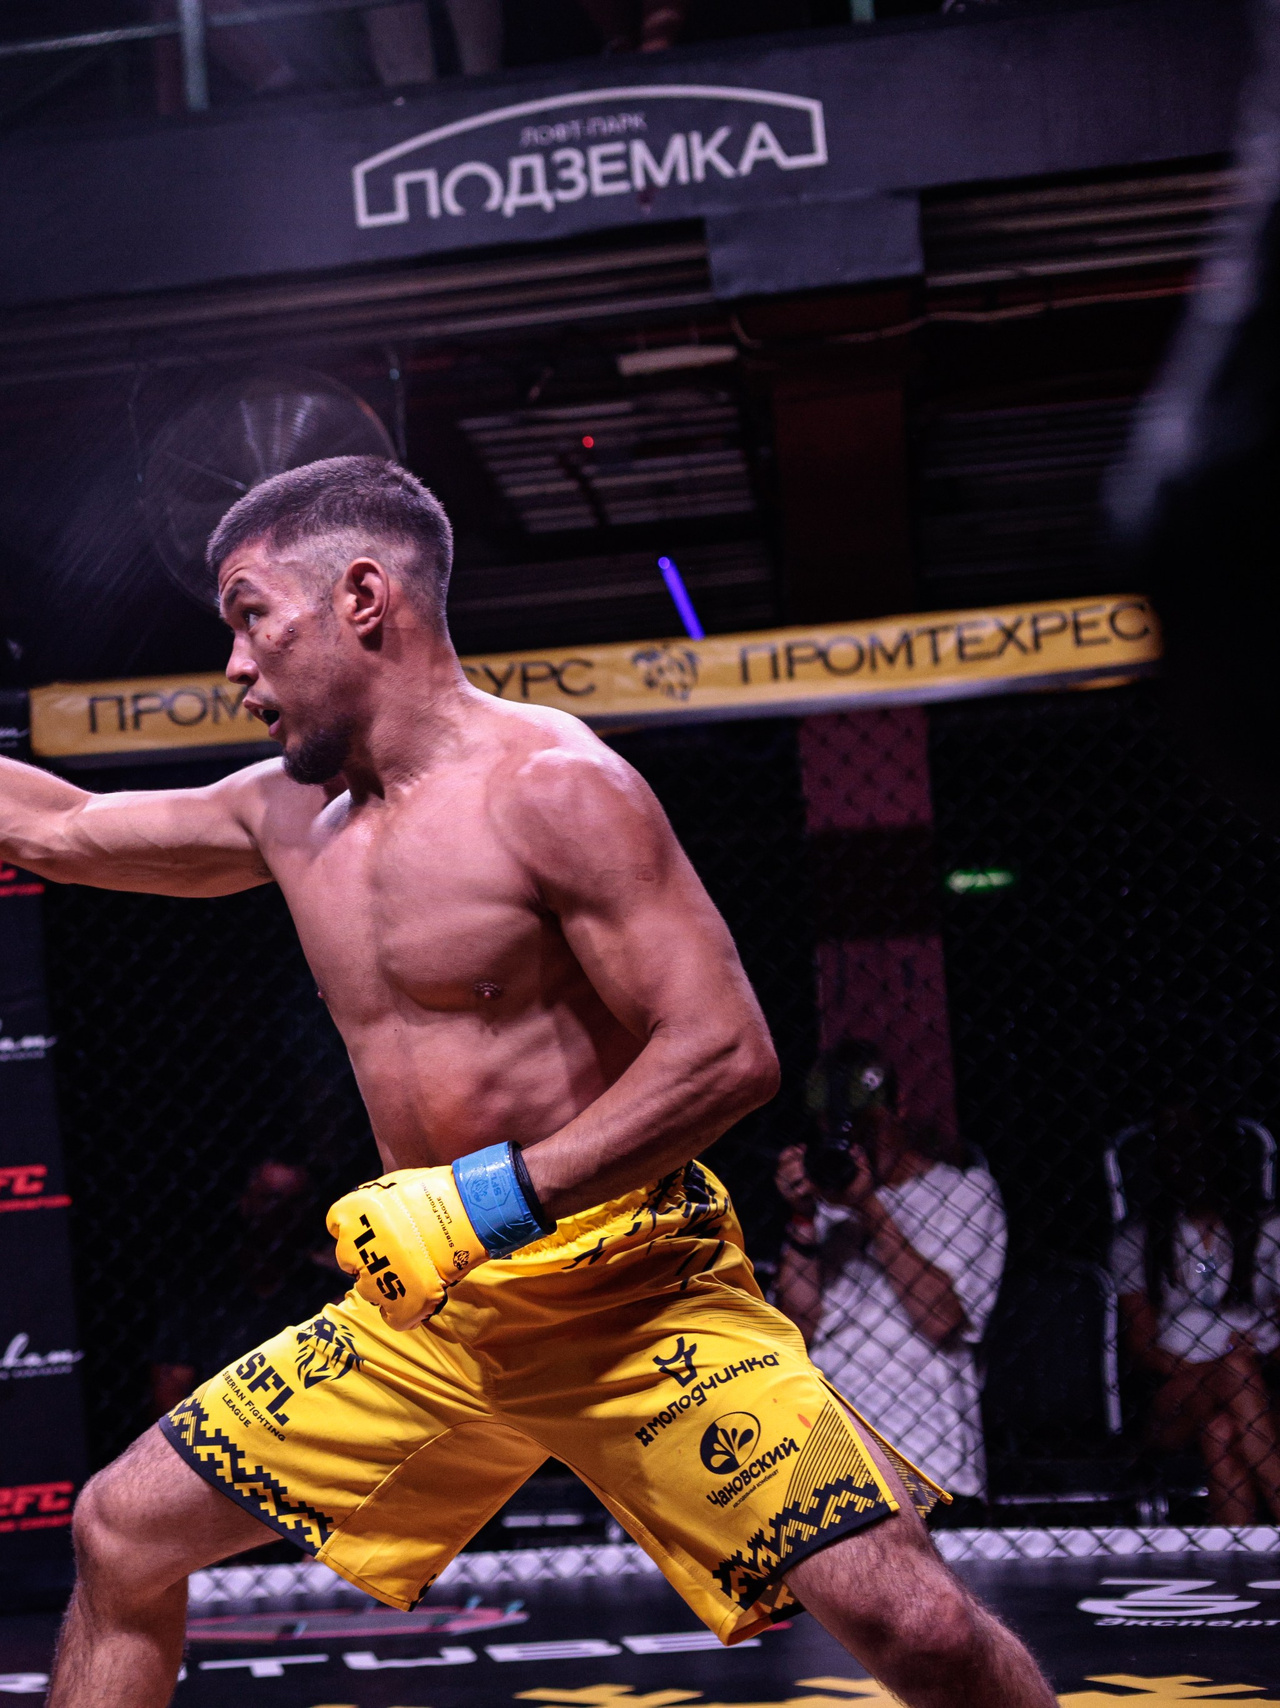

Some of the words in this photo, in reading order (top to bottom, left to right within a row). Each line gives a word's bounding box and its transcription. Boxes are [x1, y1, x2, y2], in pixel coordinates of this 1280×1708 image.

[394, 121, 788, 218] ПОДЗЕМКА
[353, 1214, 406, 1300] SFL
[221, 1393, 252, 1428] LEAGUE
[222, 1370, 246, 1401] SIBERIAN
[244, 1400, 287, 1442] FIGHTING
[235, 1352, 295, 1427] SFL
